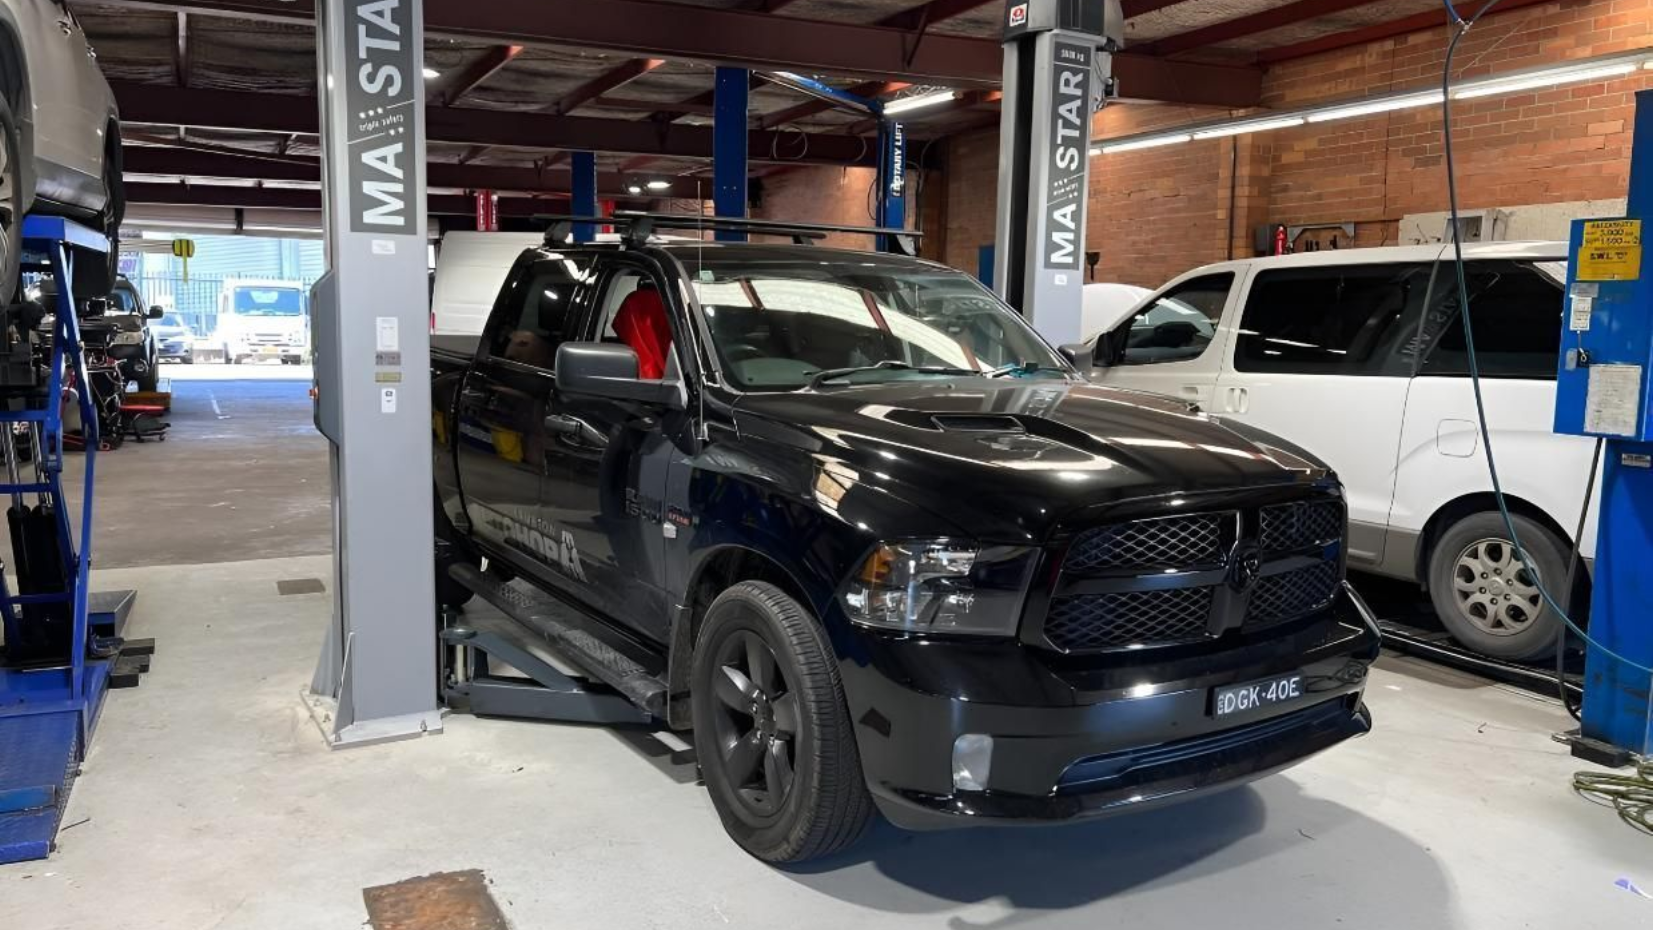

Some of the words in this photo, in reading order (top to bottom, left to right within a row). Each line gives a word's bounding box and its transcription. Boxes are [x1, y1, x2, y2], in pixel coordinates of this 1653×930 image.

[1056, 70, 1084, 172] STAR
[362, 142, 405, 226] MA
[1050, 203, 1077, 264] MA
